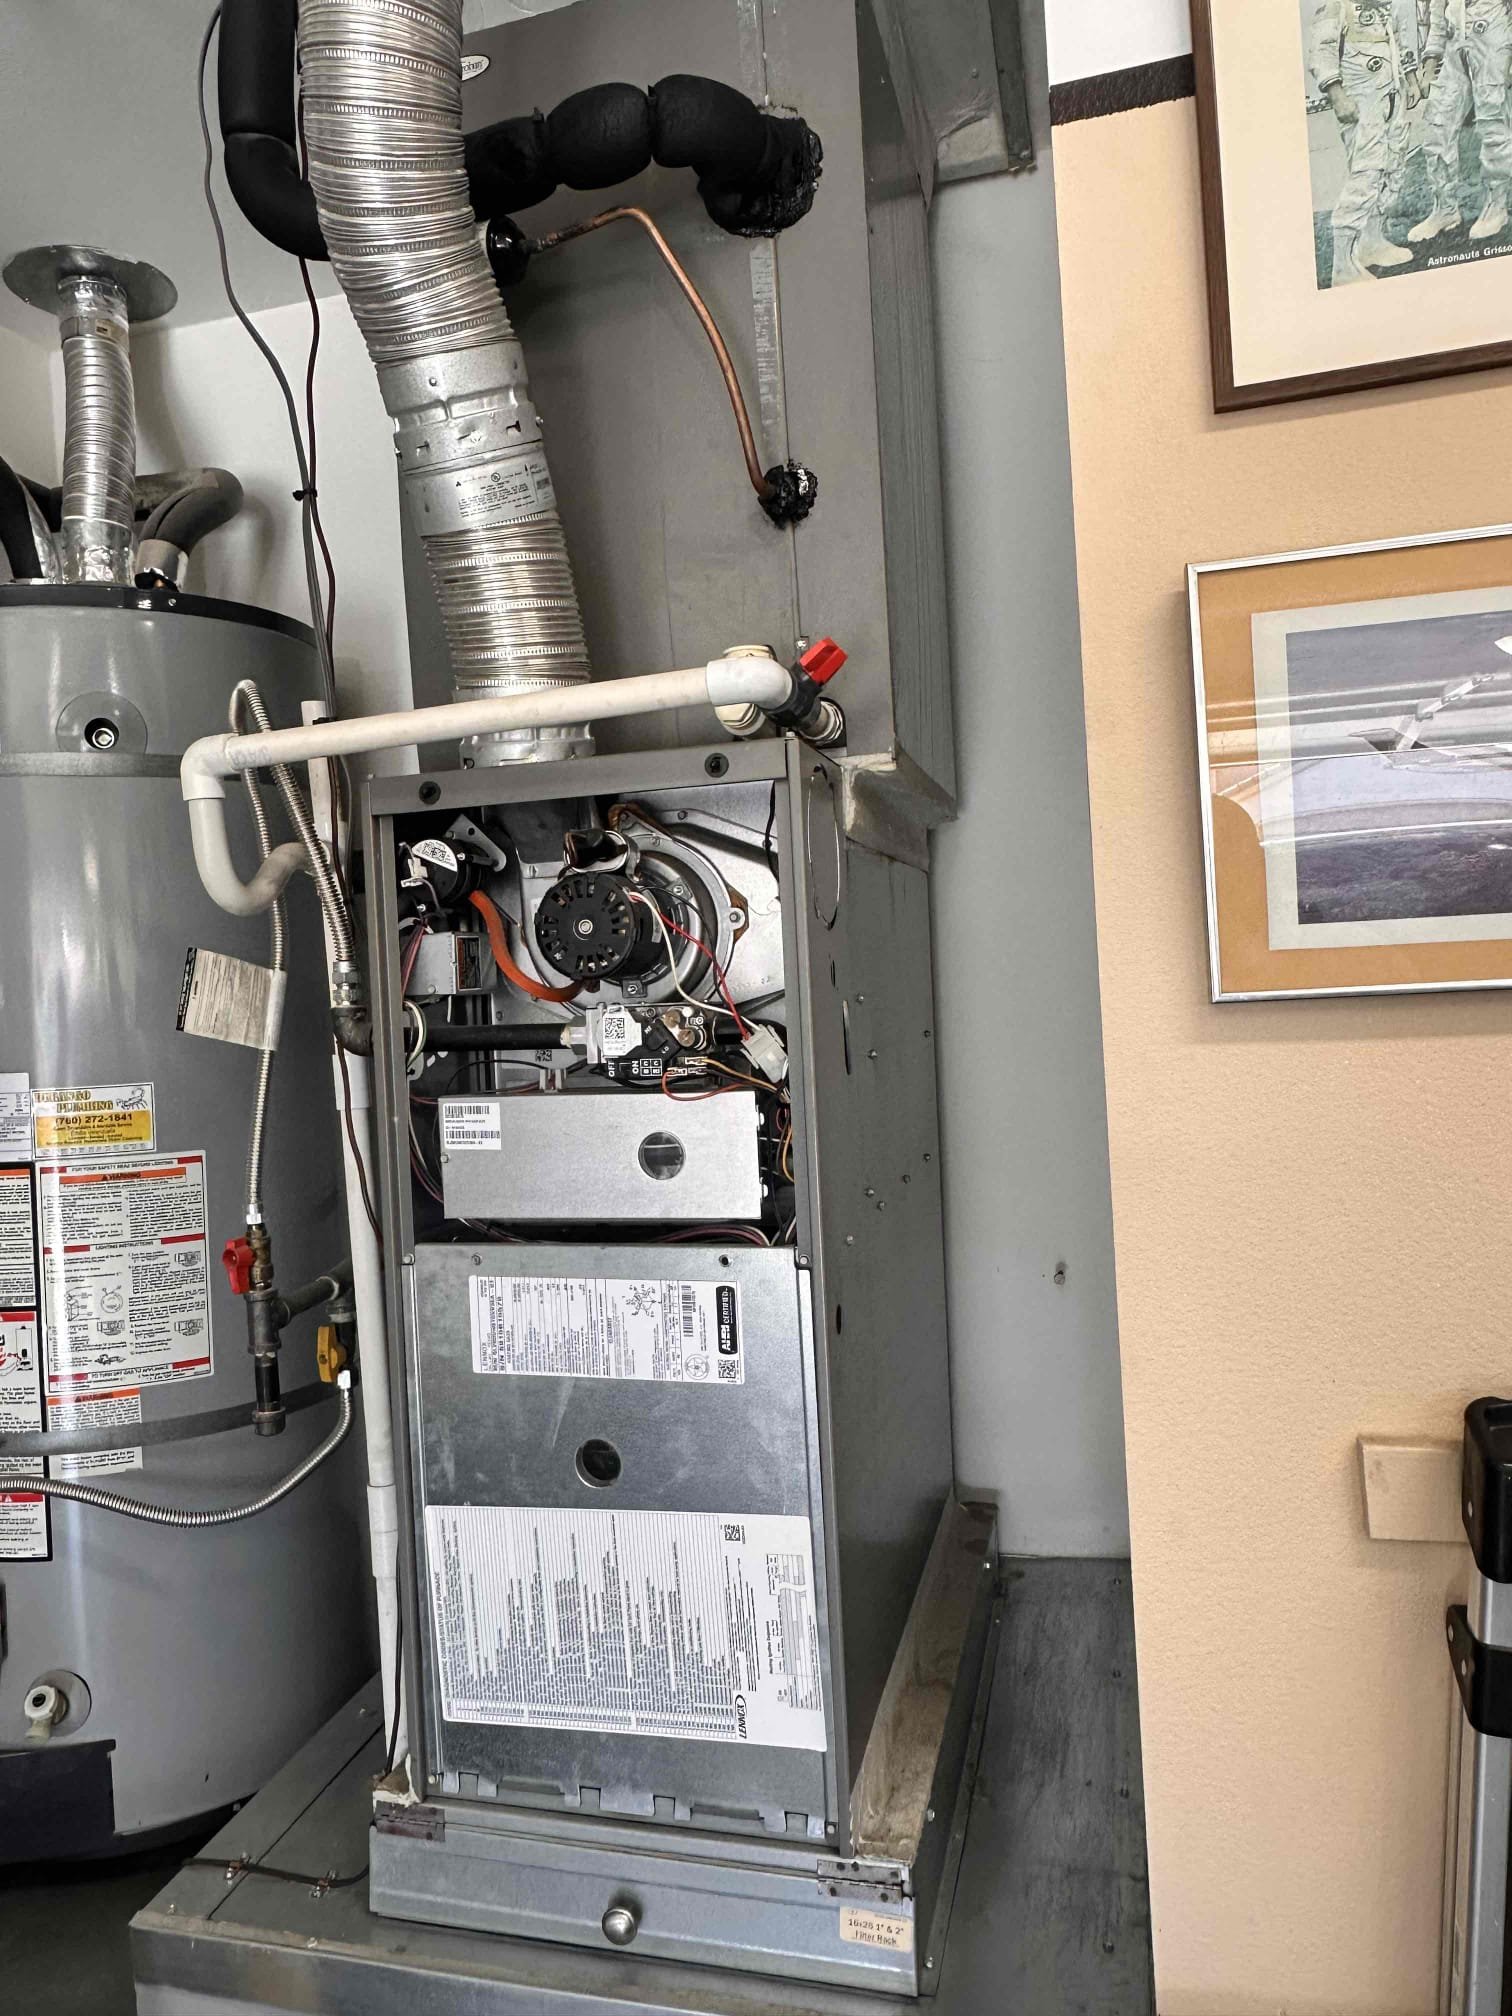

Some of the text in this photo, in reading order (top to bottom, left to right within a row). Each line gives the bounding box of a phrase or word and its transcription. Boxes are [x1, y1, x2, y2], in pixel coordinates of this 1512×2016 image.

[1427, 250, 1480, 267] Astronauts
[631, 1060, 639, 1074] ON
[737, 1704, 746, 1739] LENNOX
